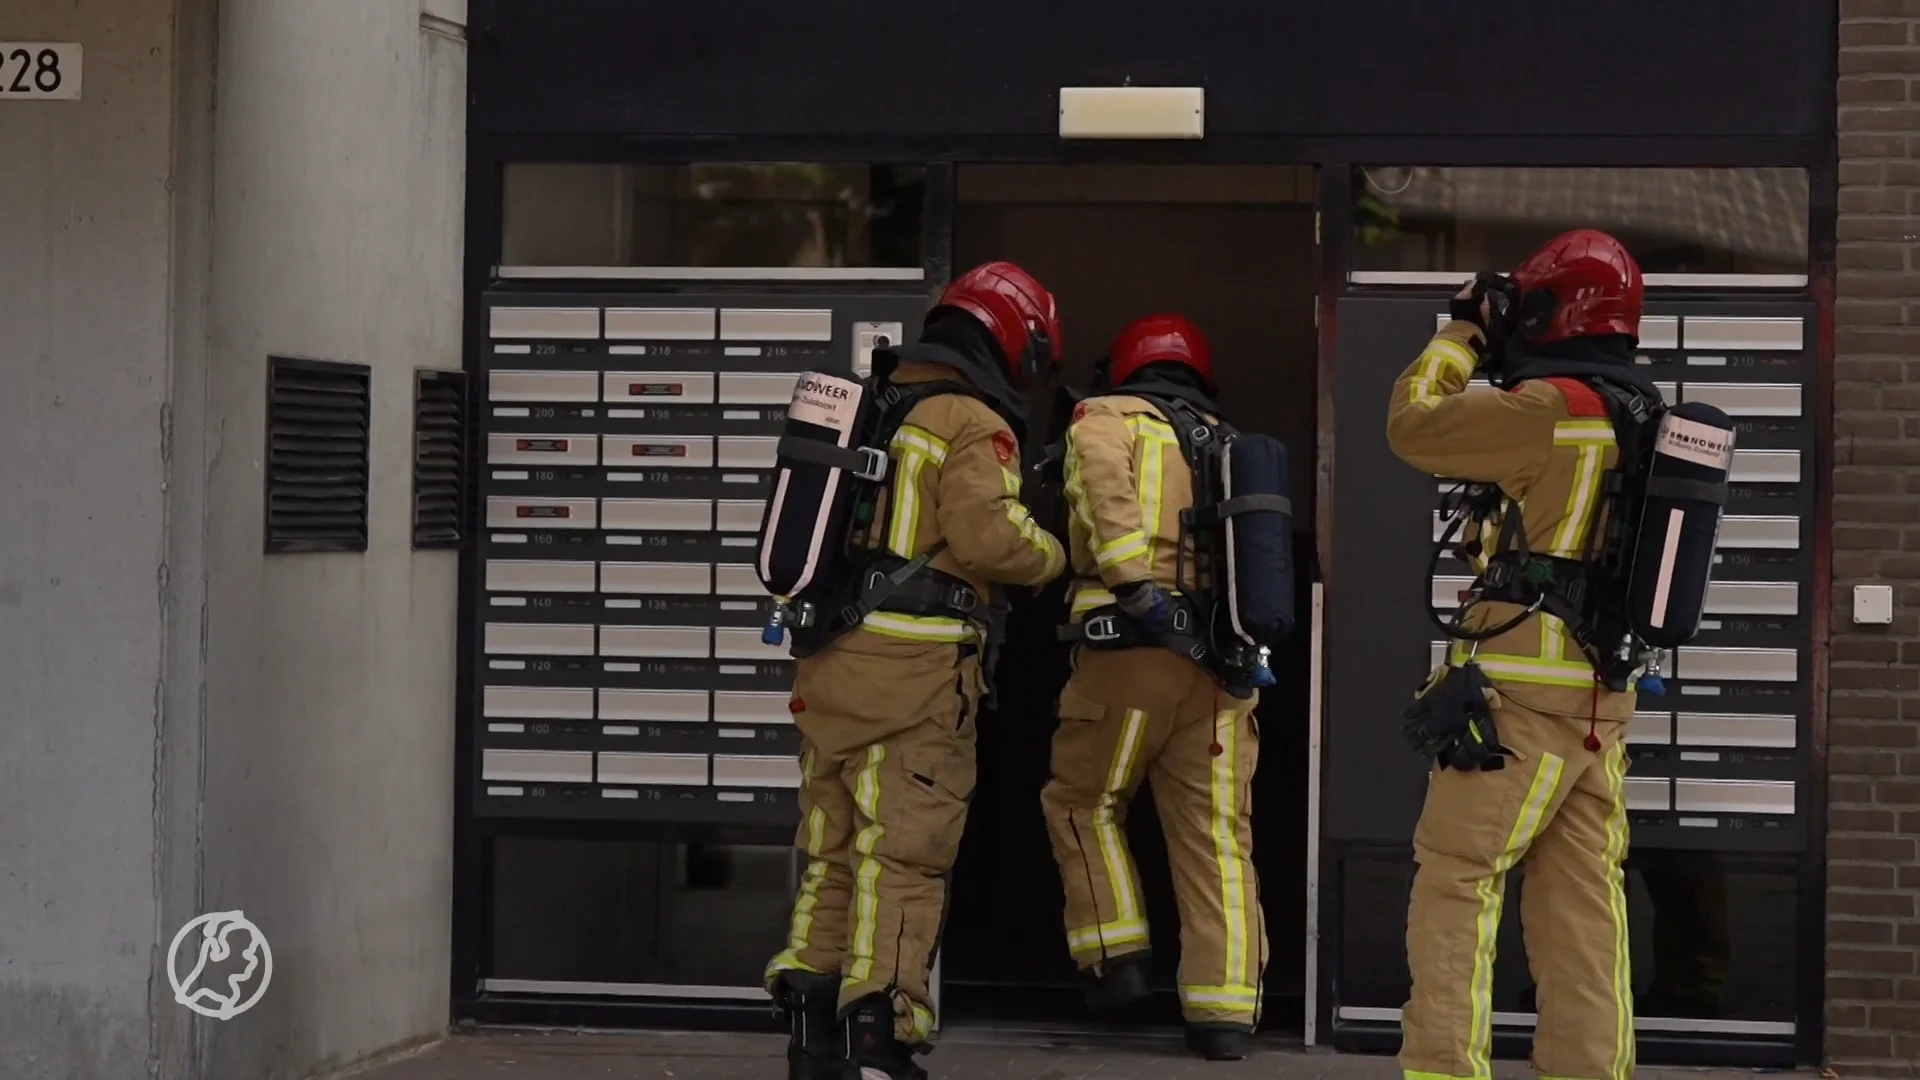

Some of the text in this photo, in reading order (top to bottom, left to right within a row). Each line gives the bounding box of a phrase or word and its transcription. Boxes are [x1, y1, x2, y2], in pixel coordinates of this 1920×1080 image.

[0, 48, 62, 93] 28
[535, 344, 556, 356] 220
[651, 345, 672, 357] 218
[1732, 356, 1754, 368] 210
[534, 407, 555, 419] 200
[651, 409, 670, 420] 198
[766, 410, 786, 421] 196
[650, 472, 669, 483] 178
[1731, 488, 1752, 499] 170
[649, 535, 668, 547] 158
[1731, 554, 1751, 565] 150
[531, 661, 552, 672] 120
[647, 662, 666, 674] 118
[763, 666, 782, 677] 116
[531, 723, 550, 735] 100
[647, 726, 662, 737] 98
[1728, 752, 1745, 764] 90
[531, 787, 546, 797] 80
[647, 789, 661, 801] 78
[763, 792, 777, 804] 76
[1728, 818, 1743, 829] 70
